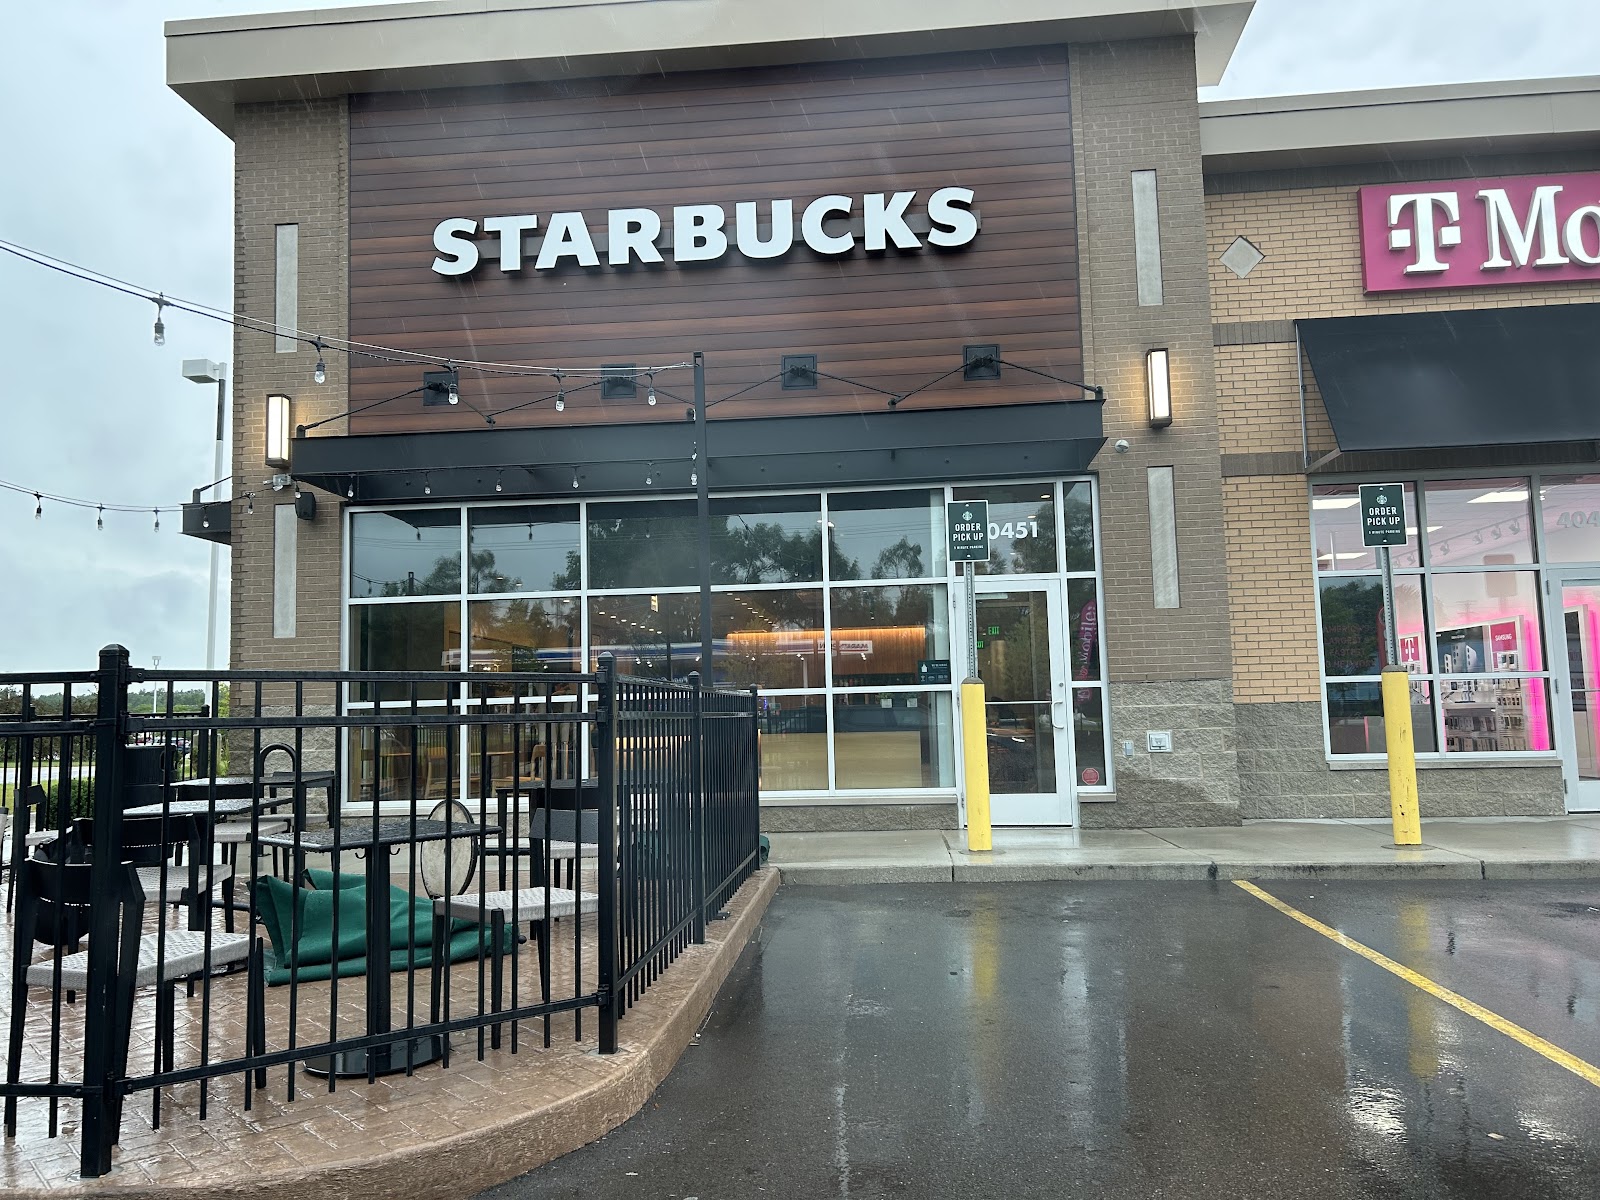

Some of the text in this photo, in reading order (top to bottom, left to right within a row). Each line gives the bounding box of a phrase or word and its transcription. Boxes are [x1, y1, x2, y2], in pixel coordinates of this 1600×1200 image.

[431, 187, 979, 277] STARBUCKS
[1368, 506, 1397, 516] ORDER
[1366, 516, 1401, 526] PICK UP
[954, 522, 981, 532] ORDER
[952, 532, 984, 542] PICK UP
[987, 626, 1000, 635] EXIT
[1494, 633, 1513, 642] SAMSUNG
